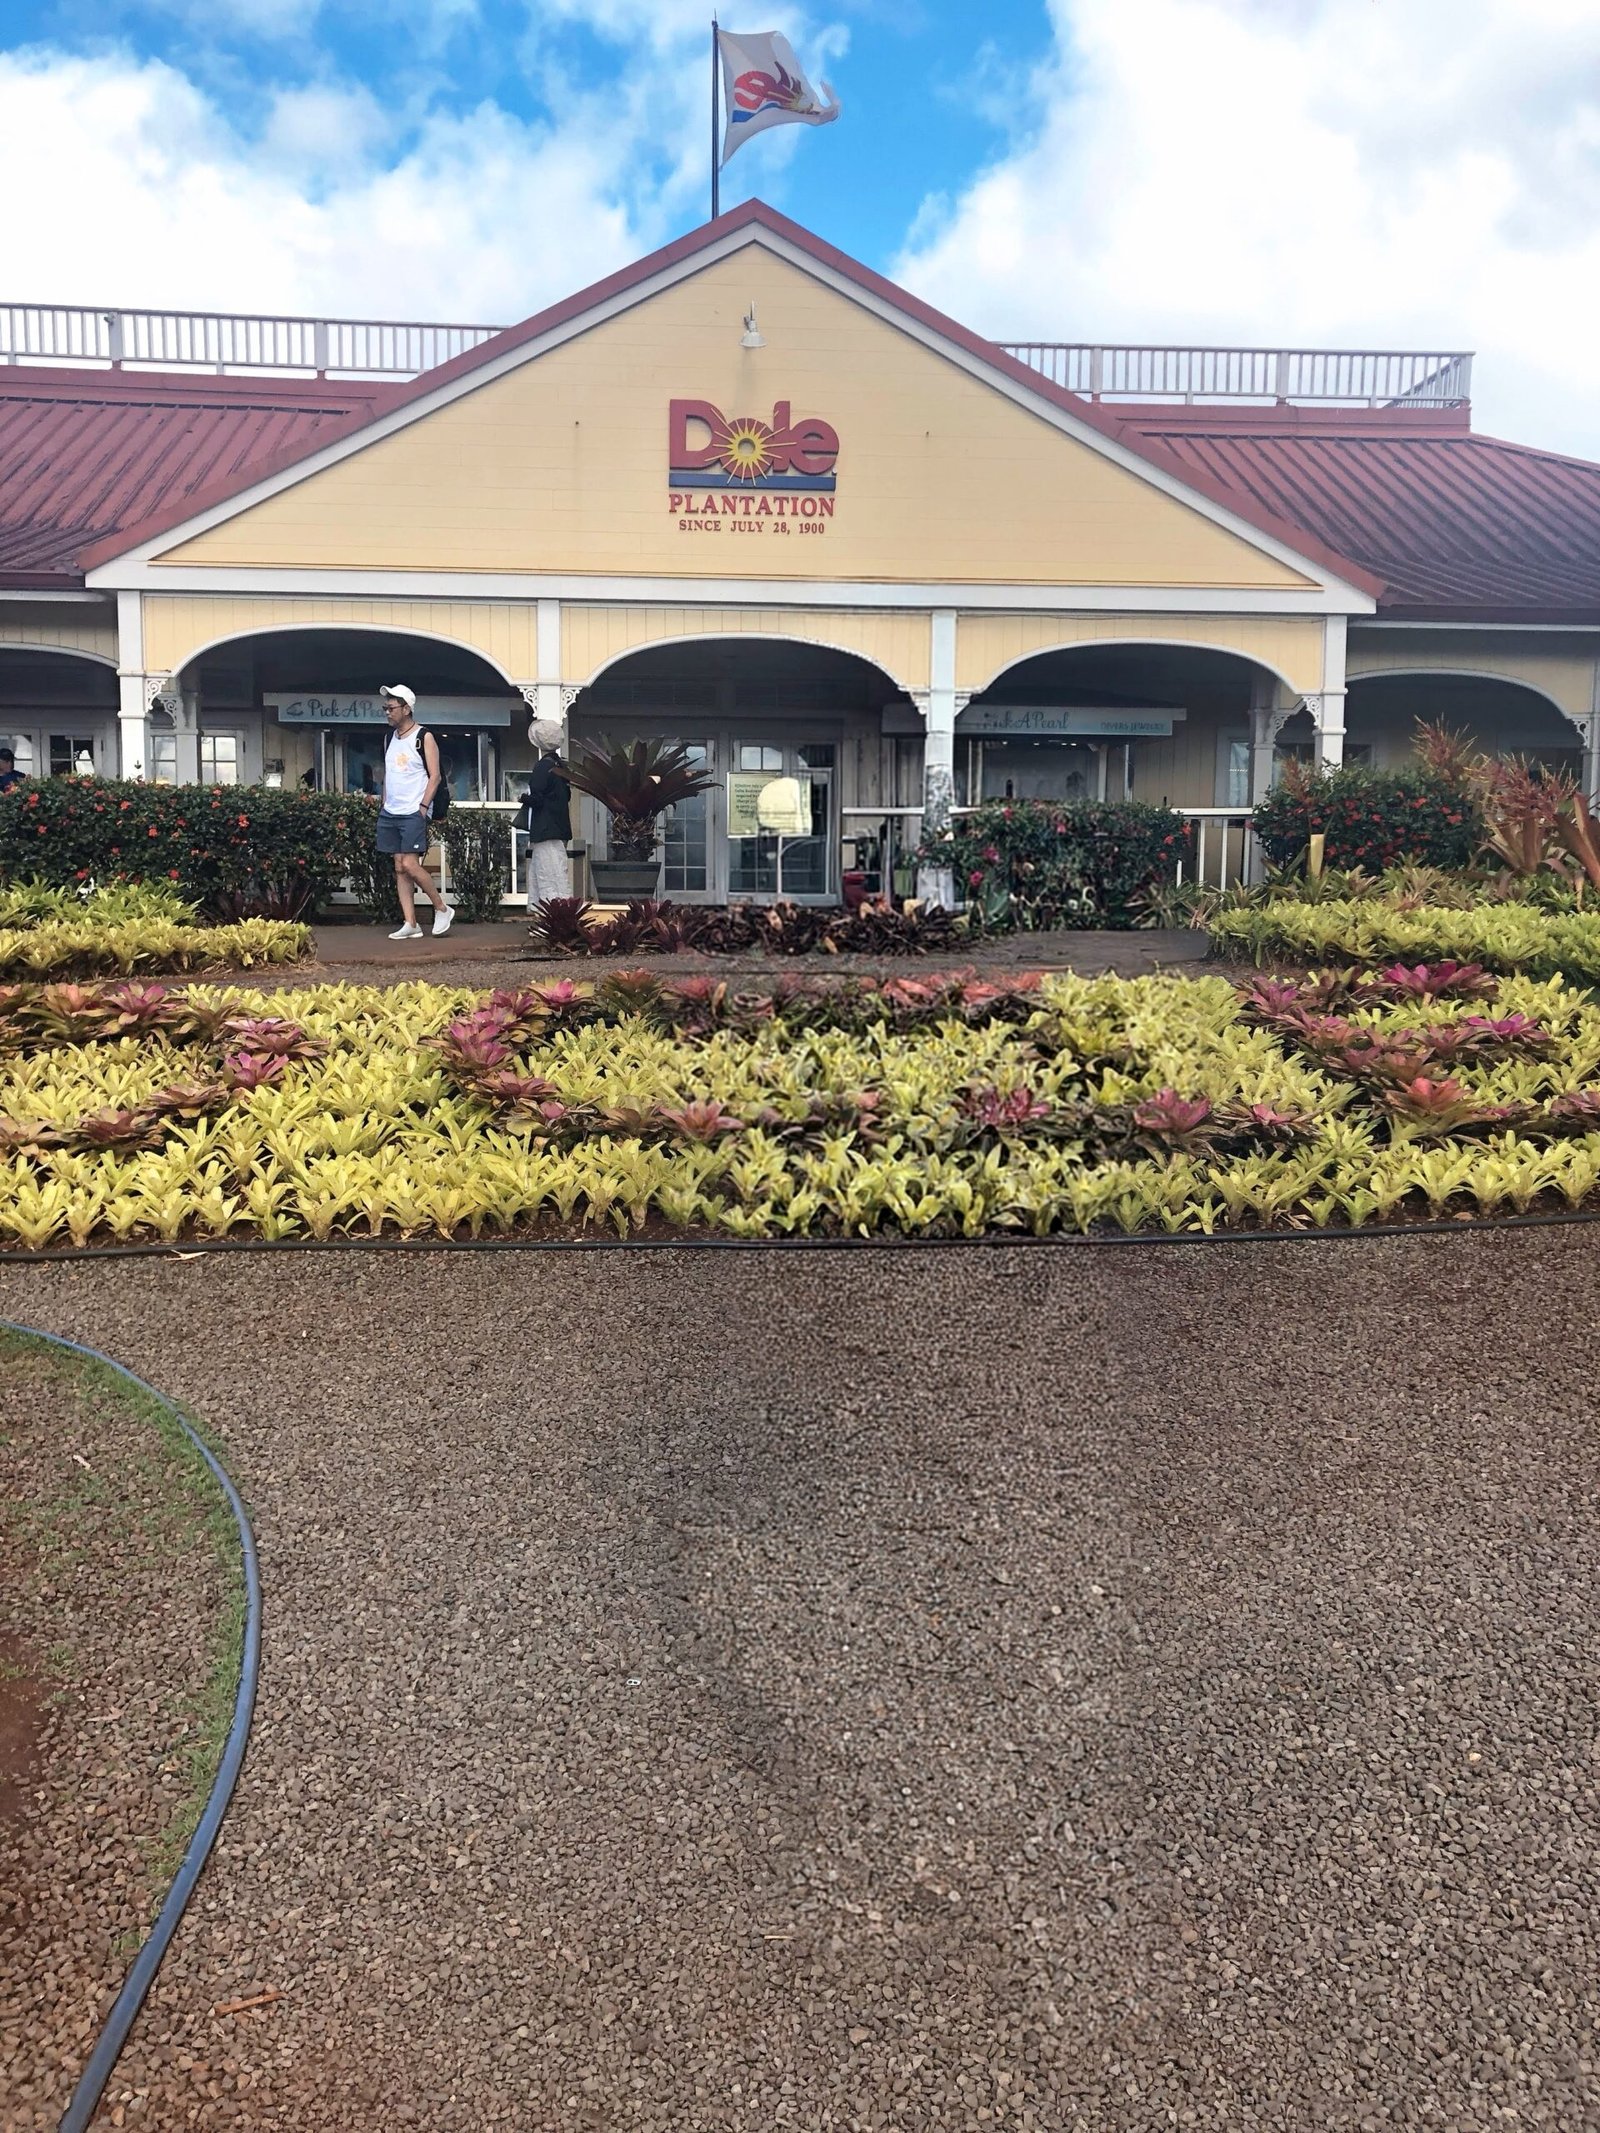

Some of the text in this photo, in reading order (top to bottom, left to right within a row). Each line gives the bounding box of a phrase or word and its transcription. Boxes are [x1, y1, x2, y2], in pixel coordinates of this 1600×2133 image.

[668, 399, 840, 480] Dole
[668, 493, 836, 517] PLANTATION
[678, 518, 825, 536] SINCE JULY 28, 1900
[307, 698, 386, 718] Pick A Pea
[1013, 711, 1031, 729] A
[1031, 711, 1070, 729] Pearl
